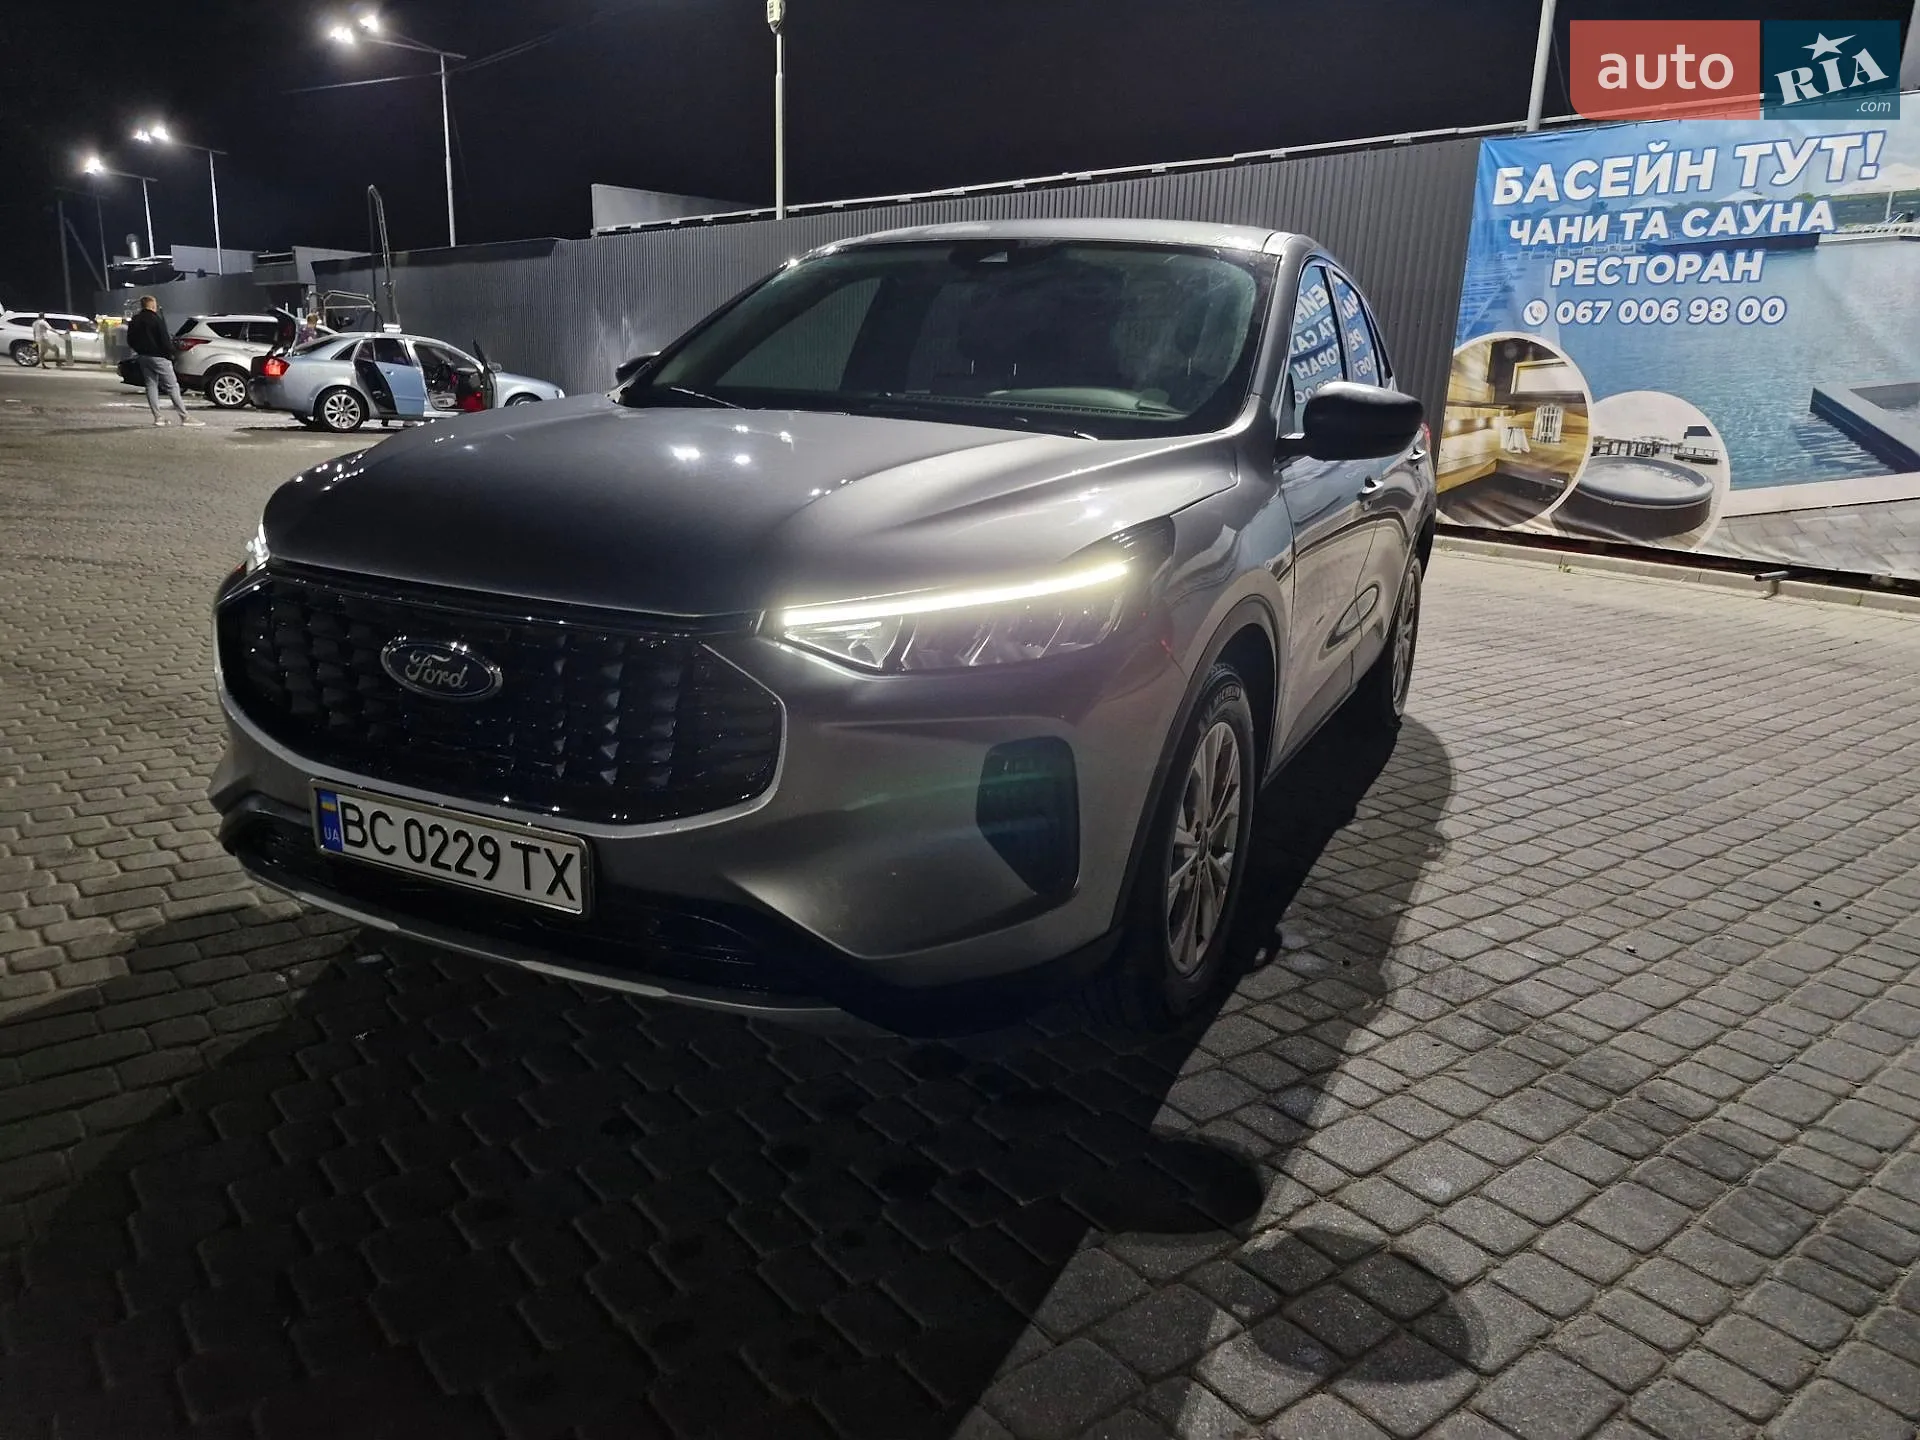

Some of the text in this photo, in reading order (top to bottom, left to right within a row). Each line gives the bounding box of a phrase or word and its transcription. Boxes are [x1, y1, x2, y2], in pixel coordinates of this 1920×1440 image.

[1493, 130, 1887, 206] БАСЕЙН ТУТ!
[1509, 199, 1836, 246] ЧАНИ ТА САУНА
[1551, 250, 1766, 287] РЕСТОРАН
[1555, 295, 1787, 325] 067 006 98 00
[405, 650, 468, 688] Ford
[323, 825, 341, 843] UA
[339, 800, 576, 901] BC 0229 TX
